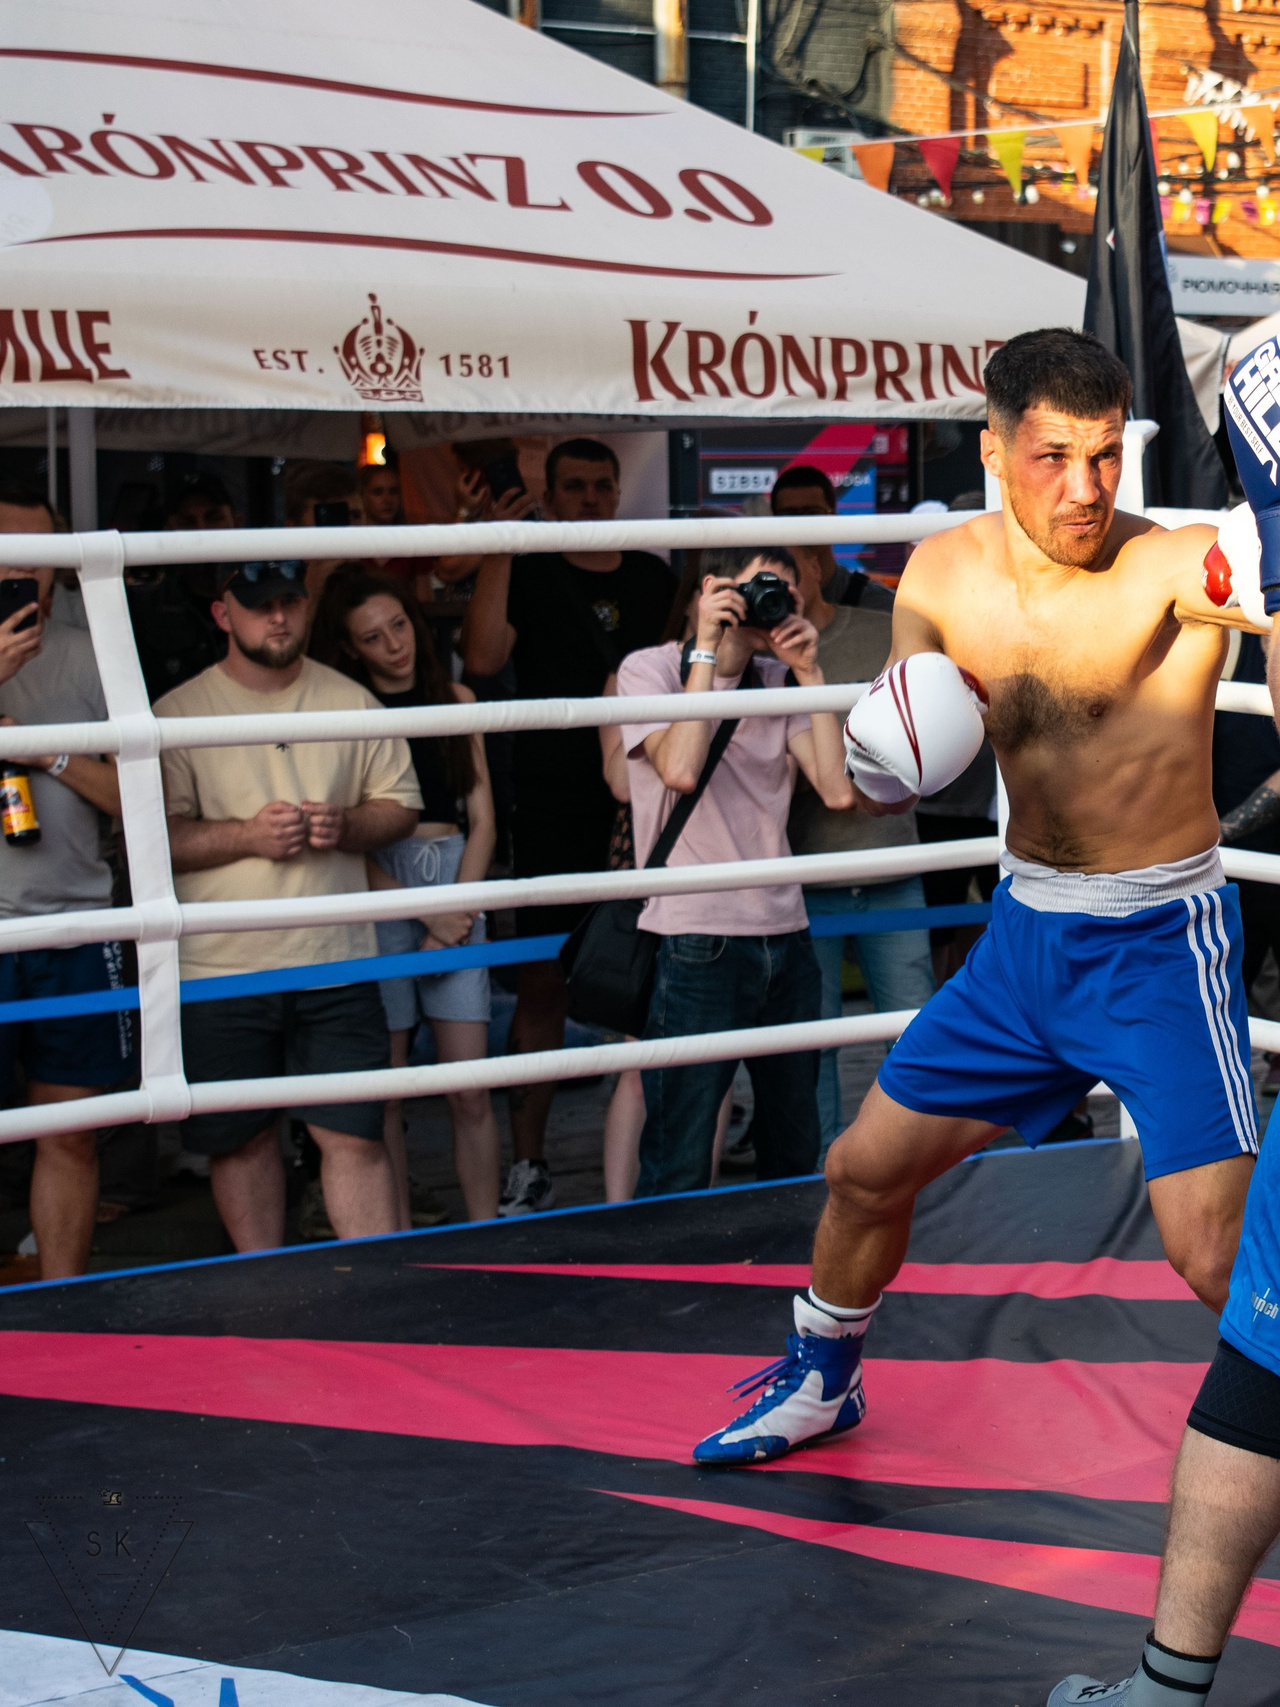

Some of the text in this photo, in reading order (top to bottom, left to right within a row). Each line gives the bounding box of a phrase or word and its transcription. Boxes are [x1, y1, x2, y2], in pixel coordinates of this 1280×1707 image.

[253, 348, 511, 379] EST. 1581
[1231, 403, 1243, 422] YOUR
[1240, 419, 1253, 438] BEST
[1250, 436, 1264, 454] SELF
